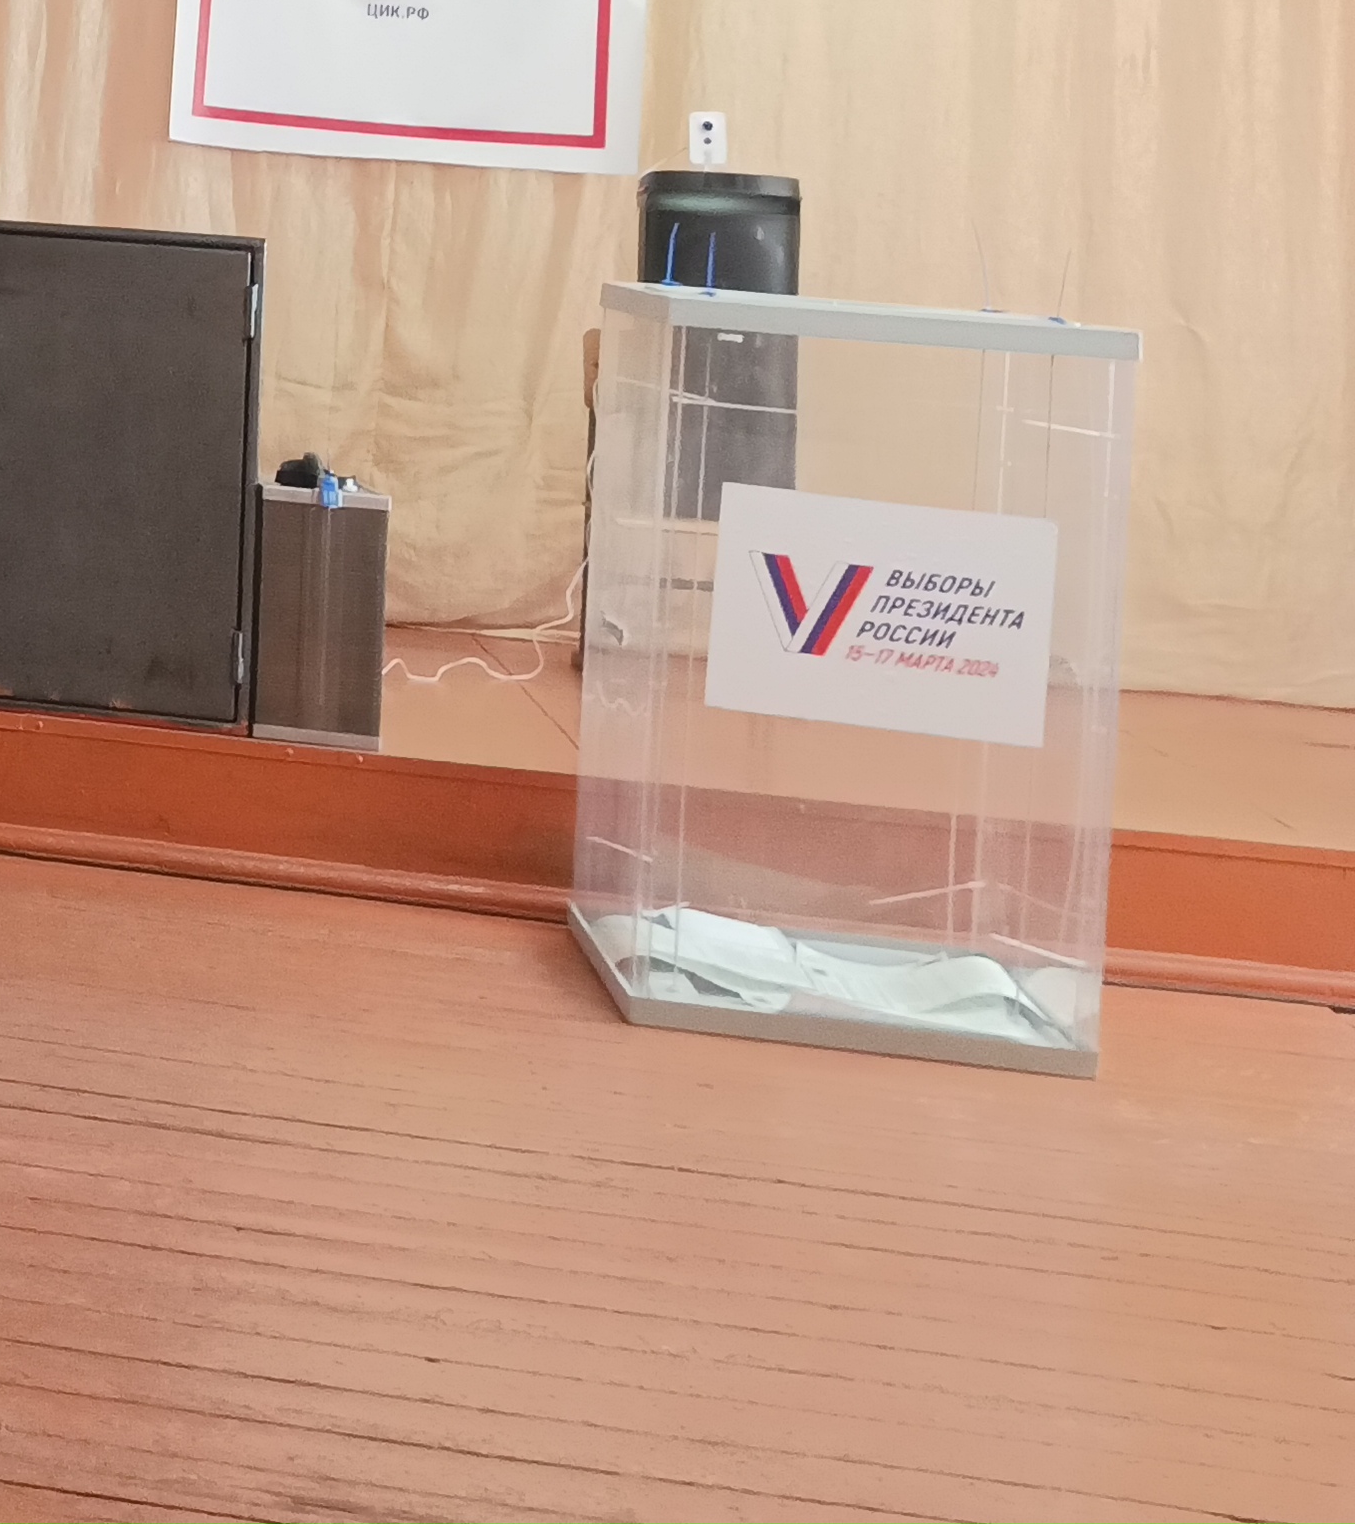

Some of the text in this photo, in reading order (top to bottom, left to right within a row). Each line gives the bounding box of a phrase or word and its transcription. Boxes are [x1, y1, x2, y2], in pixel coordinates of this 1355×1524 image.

[367, 3, 430, 21] ЦИК.РФ
[885, 569, 996, 598] ВЫБОРЫ
[870, 595, 1026, 630] ПРЕЗИДЕНТА
[856, 620, 957, 649] РОССИИ
[894, 650, 954, 674] МАРТА
[956, 657, 1000, 679] 2024
